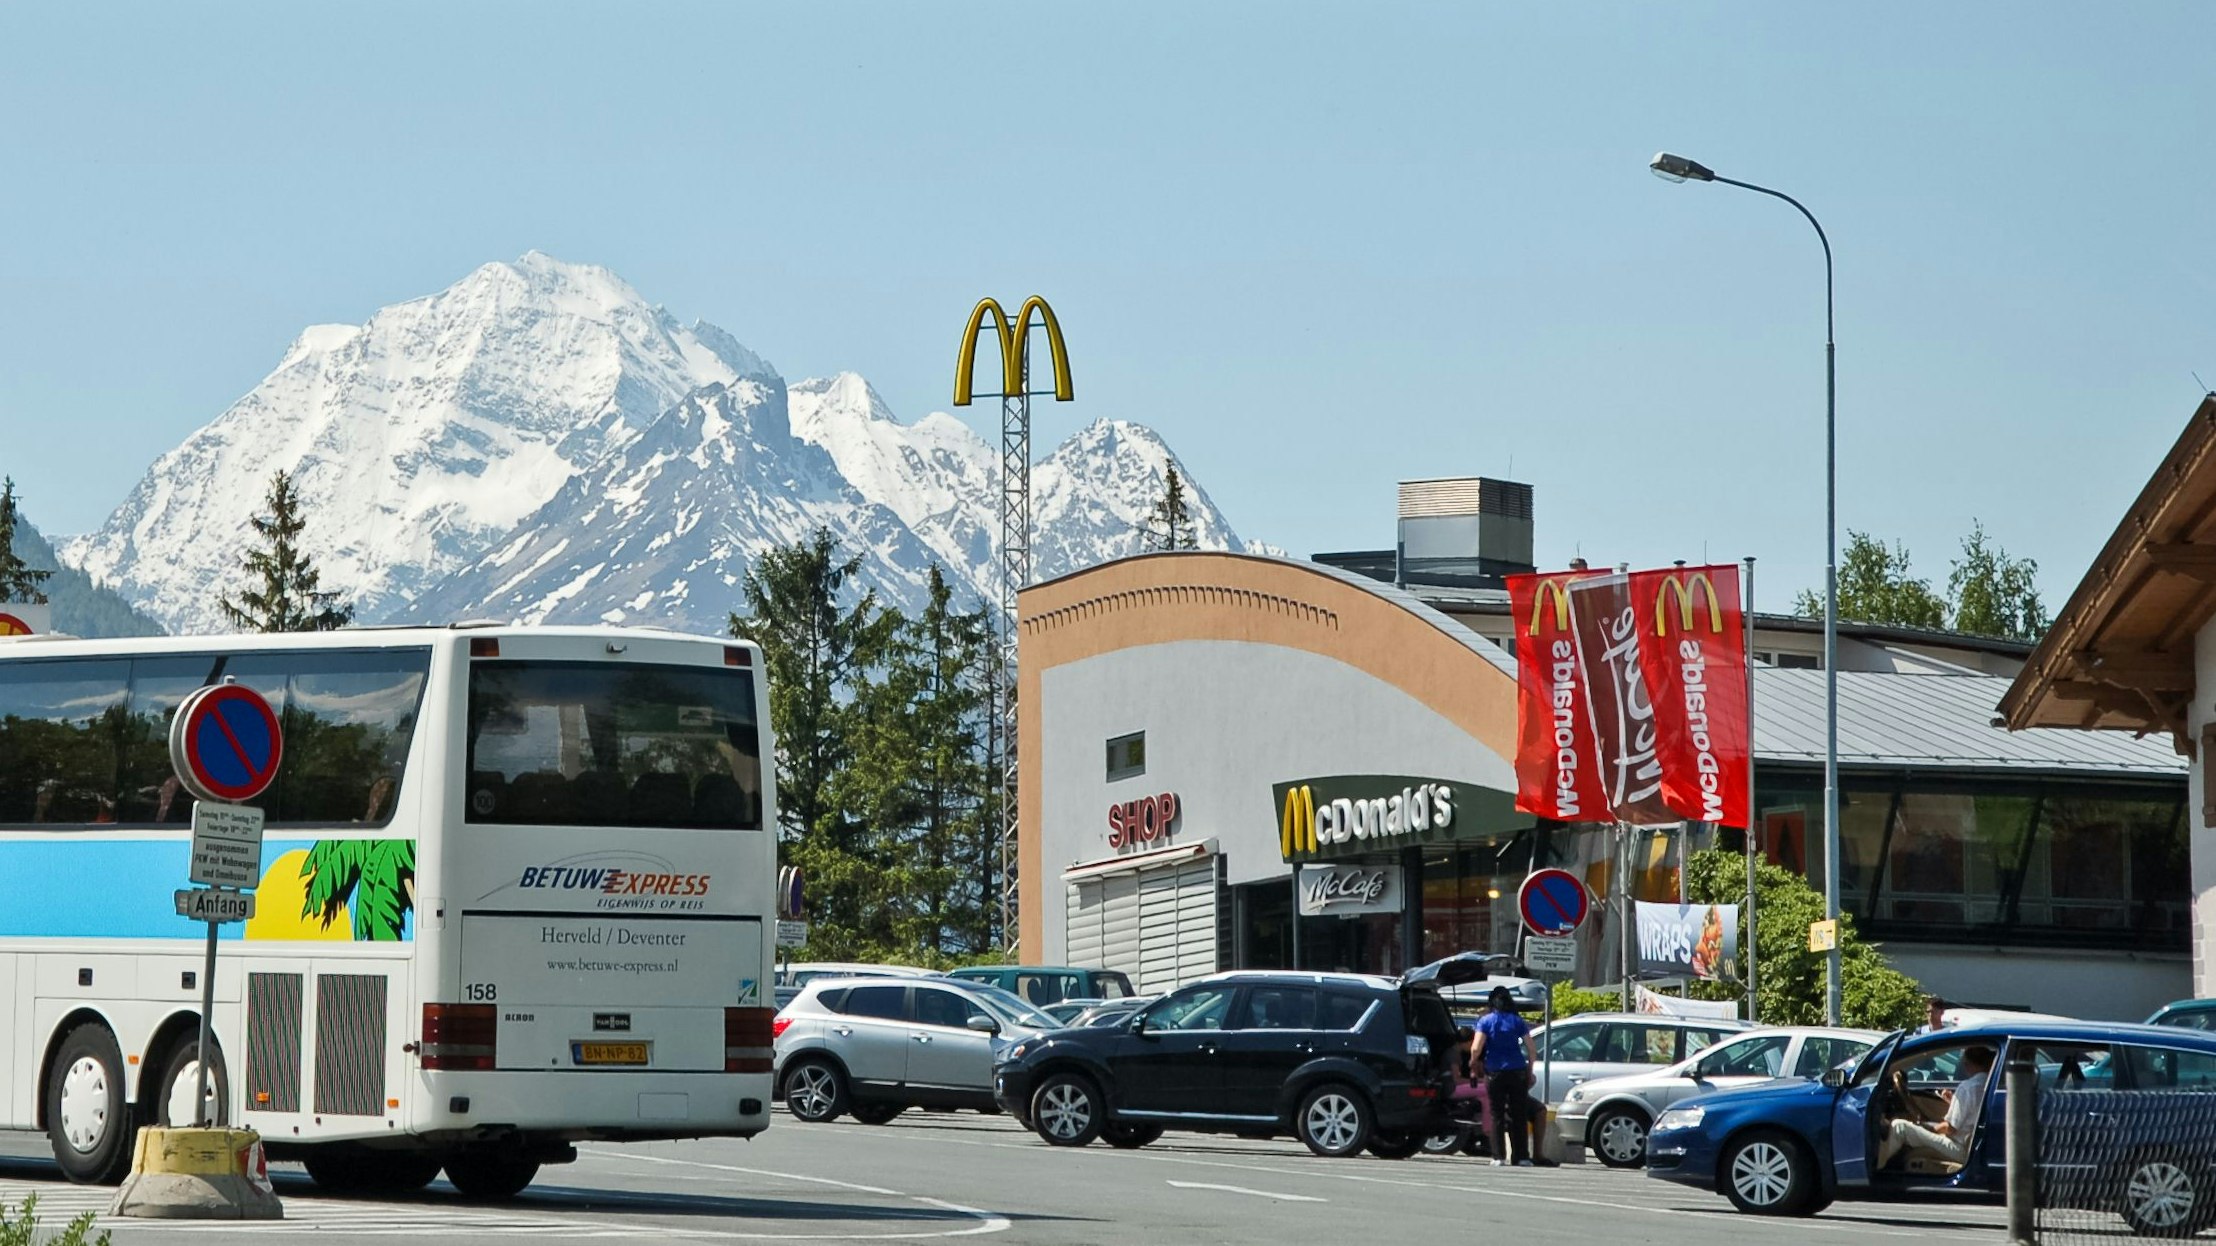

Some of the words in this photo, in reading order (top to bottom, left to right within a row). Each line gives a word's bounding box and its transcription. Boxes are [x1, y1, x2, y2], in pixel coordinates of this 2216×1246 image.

[1108, 791, 1176, 849] SHOP
[1281, 783, 1452, 857] McDonald's
[1307, 869, 1384, 906] McCafé
[195, 895, 248, 916] Anfang
[597, 899, 655, 910] EIGENWIJS
[660, 900, 675, 910] OP
[680, 900, 705, 910] REIS
[541, 927, 601, 944] Herveld
[617, 929, 686, 946] Deventer
[1639, 920, 1693, 965] WRAPS
[547, 957, 678, 975] www.betuwe-express.nl
[465, 983, 497, 1001] 158
